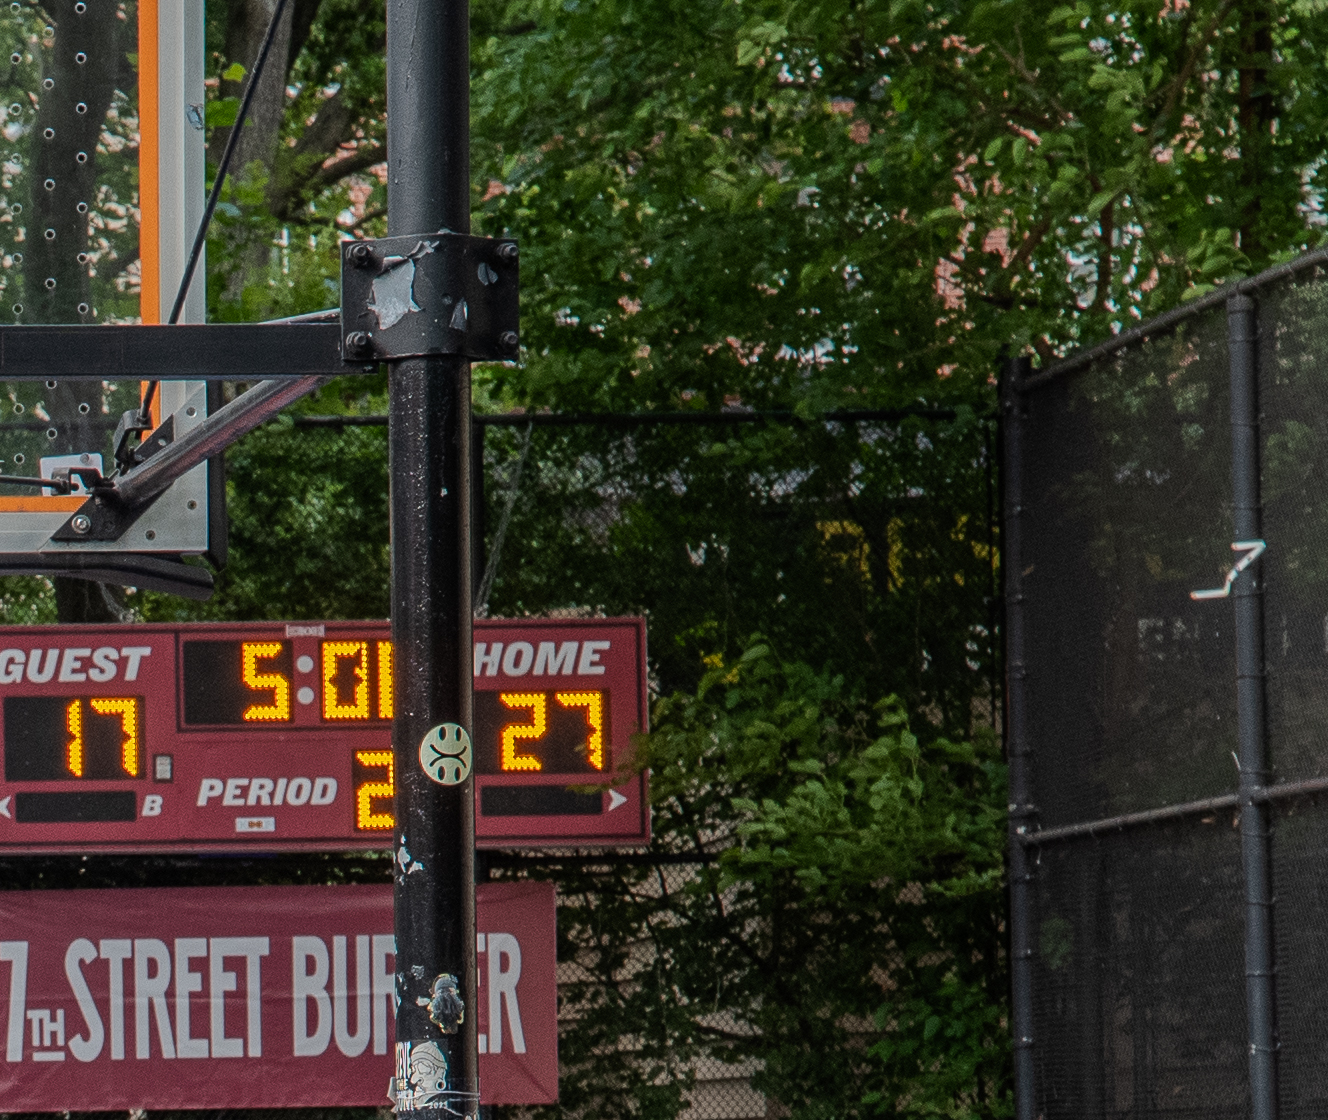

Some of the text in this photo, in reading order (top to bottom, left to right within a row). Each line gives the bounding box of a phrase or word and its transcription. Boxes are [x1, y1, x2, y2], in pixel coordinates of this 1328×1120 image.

[473, 639, 611, 677] HOME
[64, 697, 140, 778] 17
[498, 691, 604, 772] 27
[141, 794, 164, 817] B
[196, 777, 338, 807] PERIOD
[355, 750, 395, 831] 2
[64, 936, 270, 1062] STREET
[292, 932, 527, 1059] BURR
